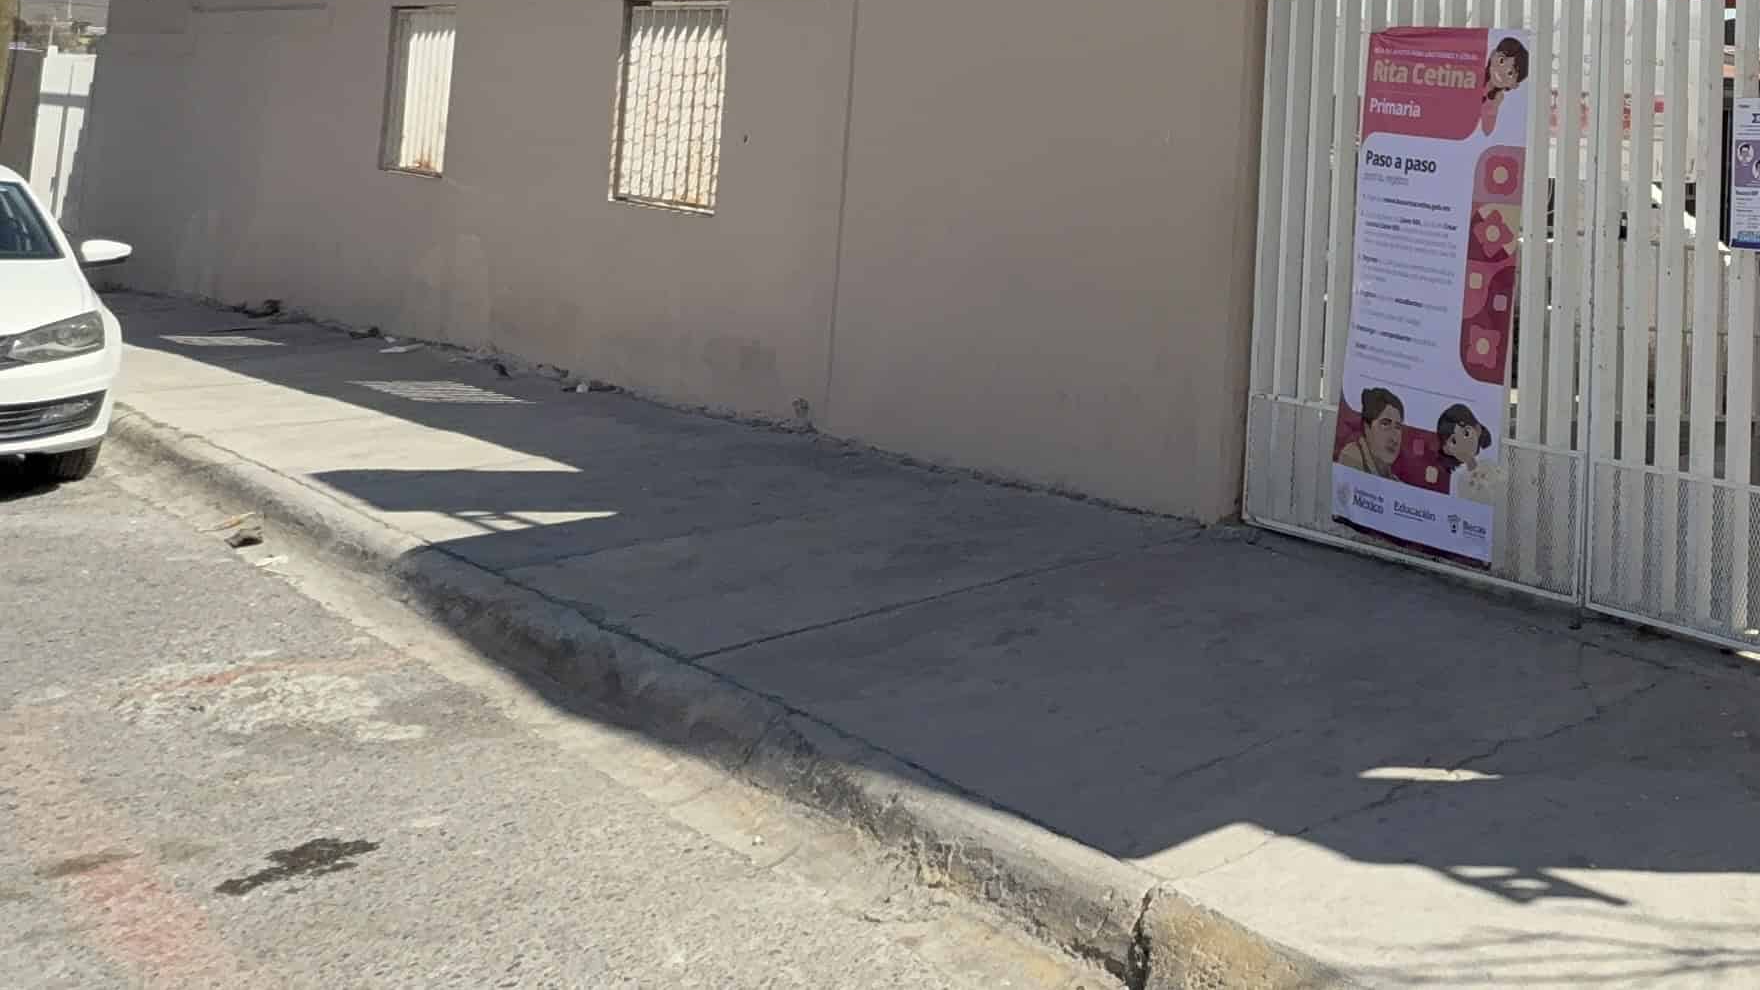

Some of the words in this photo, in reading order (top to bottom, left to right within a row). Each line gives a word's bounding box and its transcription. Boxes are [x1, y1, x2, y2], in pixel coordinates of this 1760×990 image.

[1373, 60, 1409, 83] Rita
[1412, 63, 1478, 89] Cetina
[1369, 97, 1421, 118] Primaria
[1366, 150, 1393, 168] Paso
[1394, 156, 1402, 169] a
[1404, 158, 1437, 175] paso
